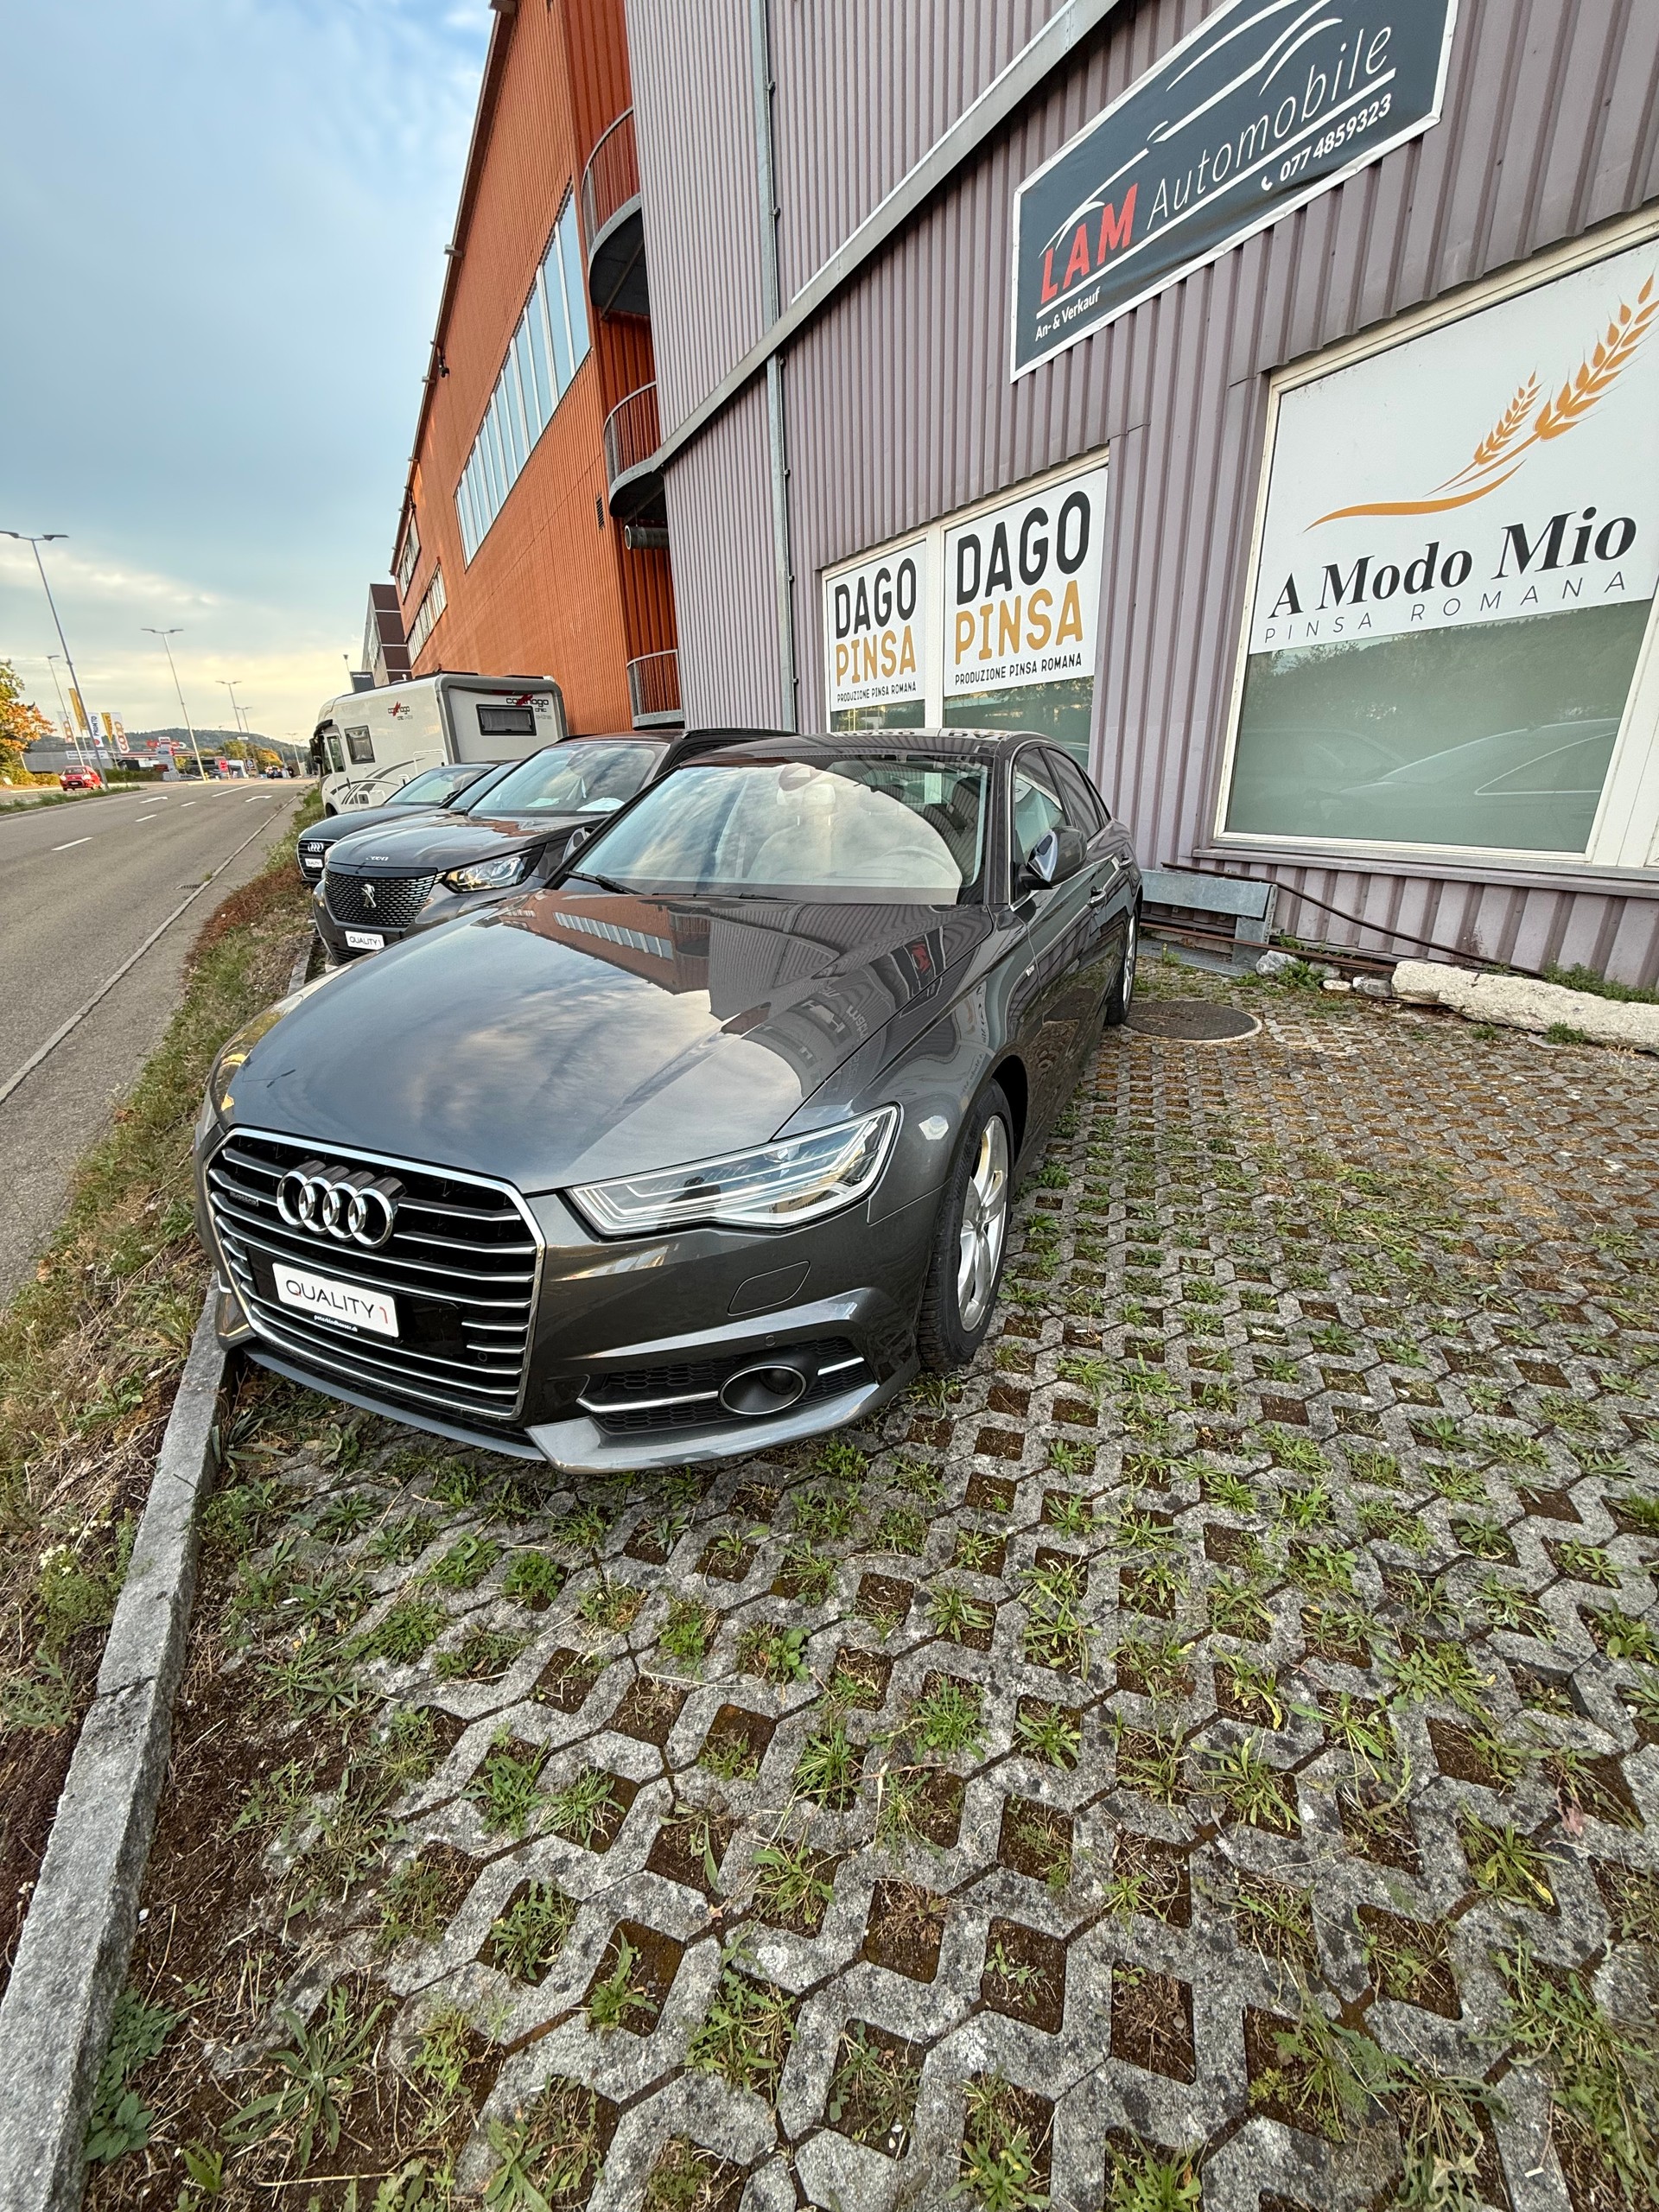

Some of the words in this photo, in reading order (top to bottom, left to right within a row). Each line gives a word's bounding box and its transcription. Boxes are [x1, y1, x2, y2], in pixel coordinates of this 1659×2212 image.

[1040, 183, 1138, 304] LAM
[1147, 26, 1391, 231] Automobile
[1280, 146, 1312, 181] 077
[1313, 92, 1392, 159] 4859323
[1035, 324, 1052, 341] An-
[1052, 314, 1060, 329] &
[1062, 286, 1101, 323] Verkauf
[957, 491, 1090, 606] DAGO
[1268, 572, 1304, 620] A
[1315, 540, 1472, 611] Modo
[1490, 505, 1637, 582] Mio
[835, 557, 917, 639] DAGO
[955, 580, 1084, 665] PINSA
[1264, 612, 1373, 644] PINSA
[1410, 570, 1626, 622] ROMANA
[836, 625, 917, 687] PINSA
[836, 688, 870, 702] PRODUZIONE
[871, 685, 890, 698] PINSA
[891, 681, 917, 694] ROMANA
[955, 665, 1007, 685] PRODUZIONE
[1009, 660, 1038, 677] PINSA
[1041, 652, 1082, 672] ROMANA
[286, 1280, 374, 1319] QUALITY
